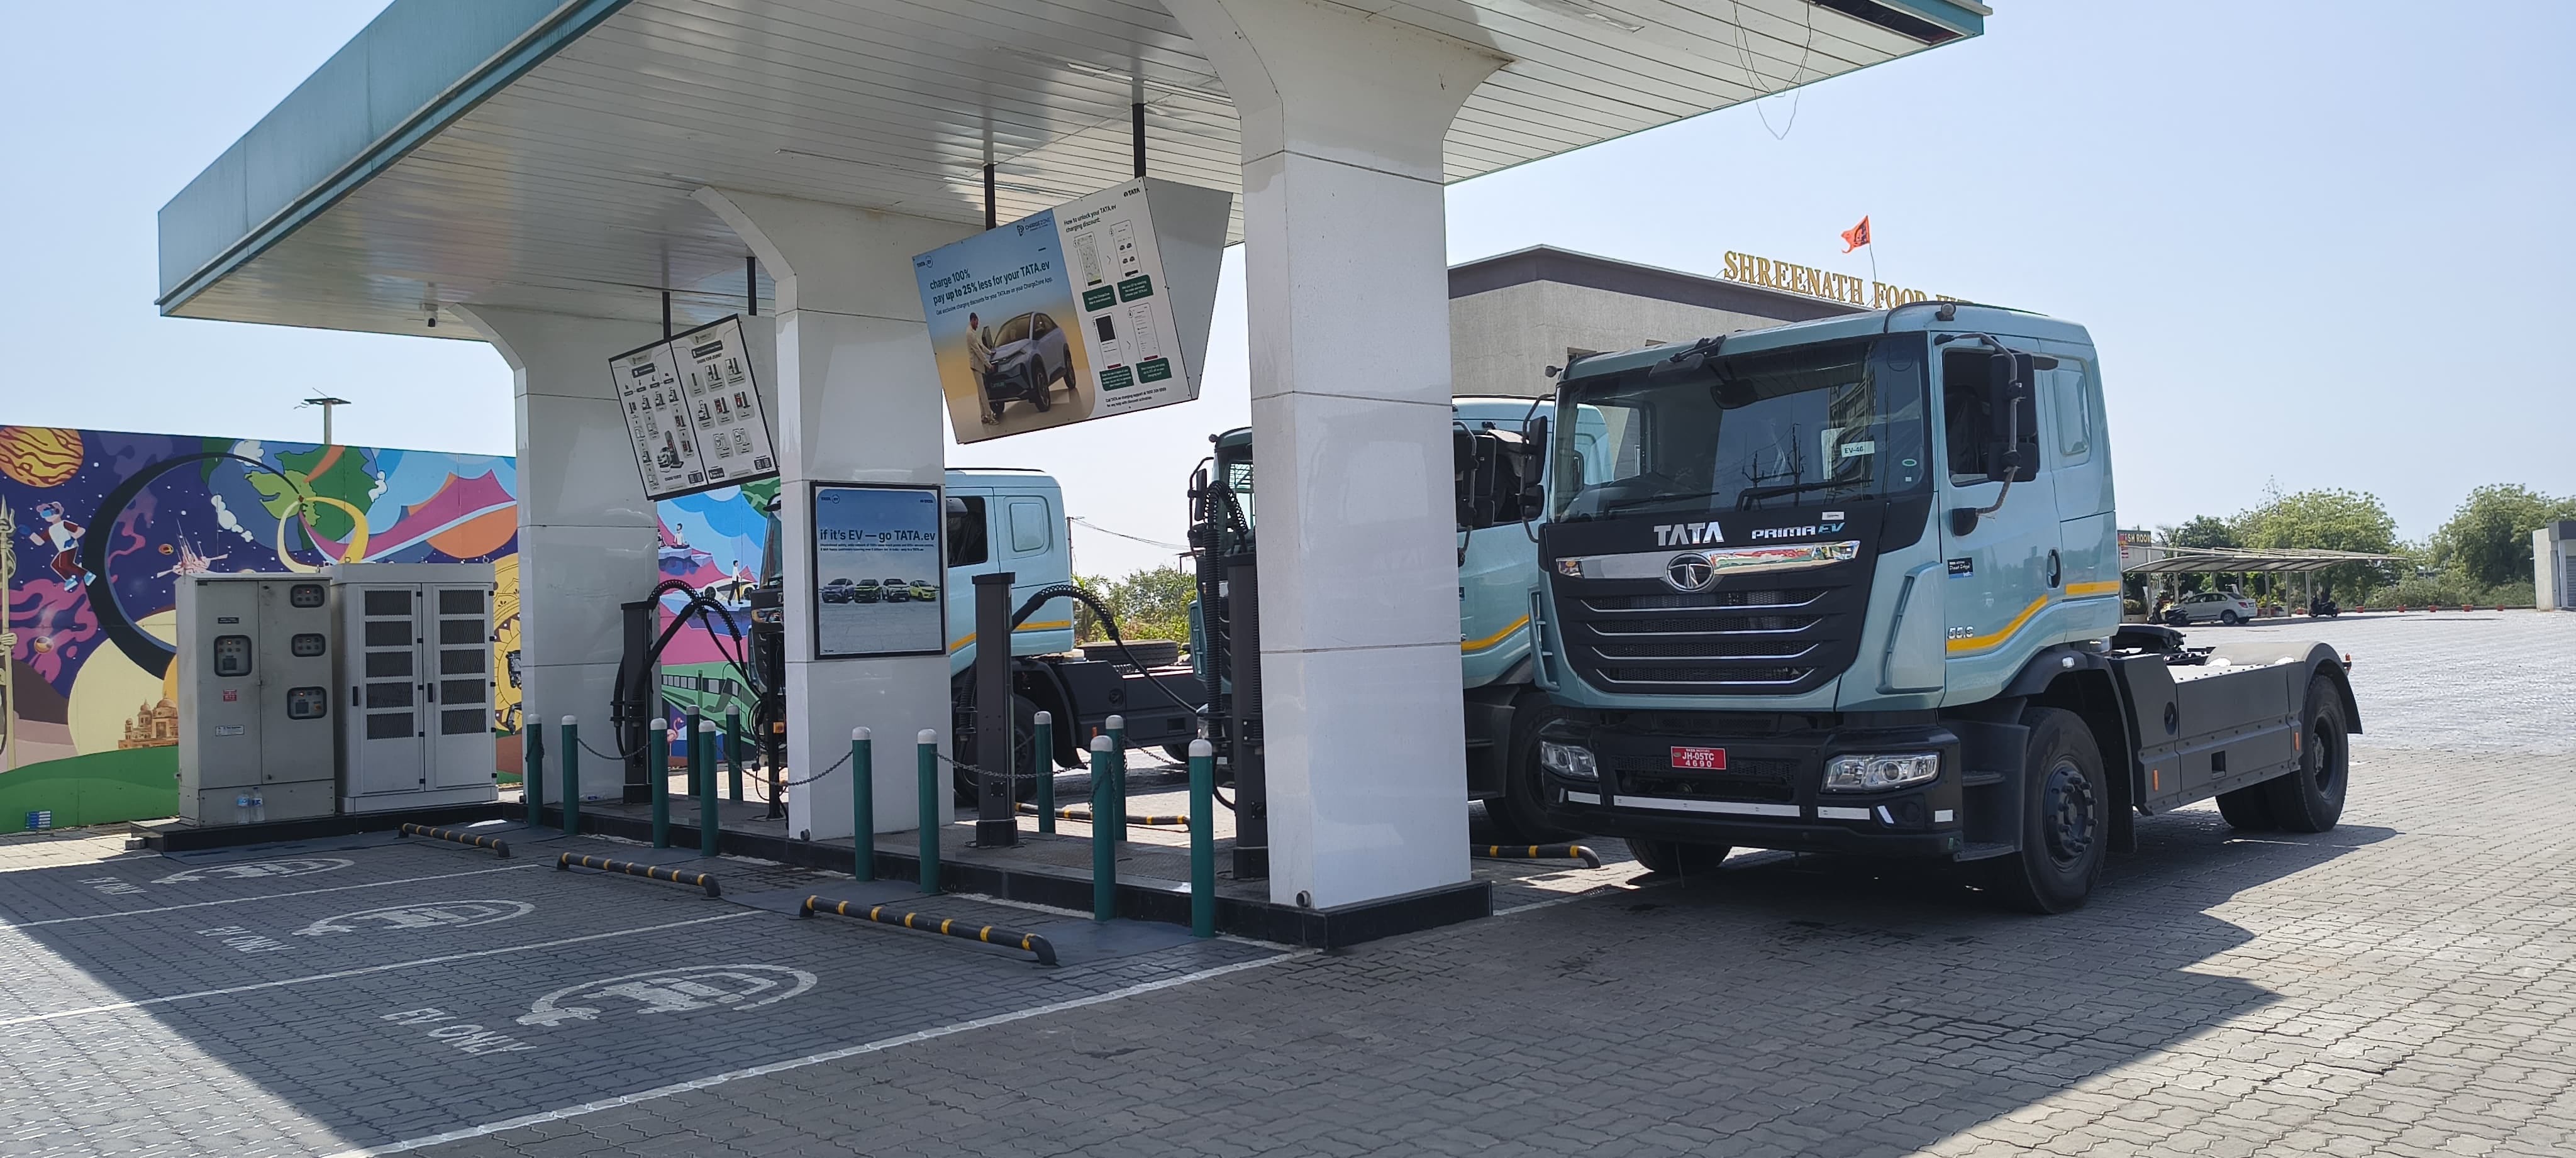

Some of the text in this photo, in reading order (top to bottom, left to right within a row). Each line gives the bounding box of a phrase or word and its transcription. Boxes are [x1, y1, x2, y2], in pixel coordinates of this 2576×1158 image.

[930, 268, 971, 290] charge 100%
[933, 261, 1050, 307] pay up to 25% less for your TATA.ev
[1724, 251, 1864, 306] SHREENATH
[820, 529, 828, 540] if
[830, 529, 846, 540] it's
[849, 530, 863, 540] EV
[879, 532, 892, 543] go
[894, 530, 936, 541] TATA.ev
[1653, 521, 1846, 546] TATA PRIMA EV
[1682, 752, 1714, 761] JH-05TC
[379, 1008, 537, 1056] EV ONLY
